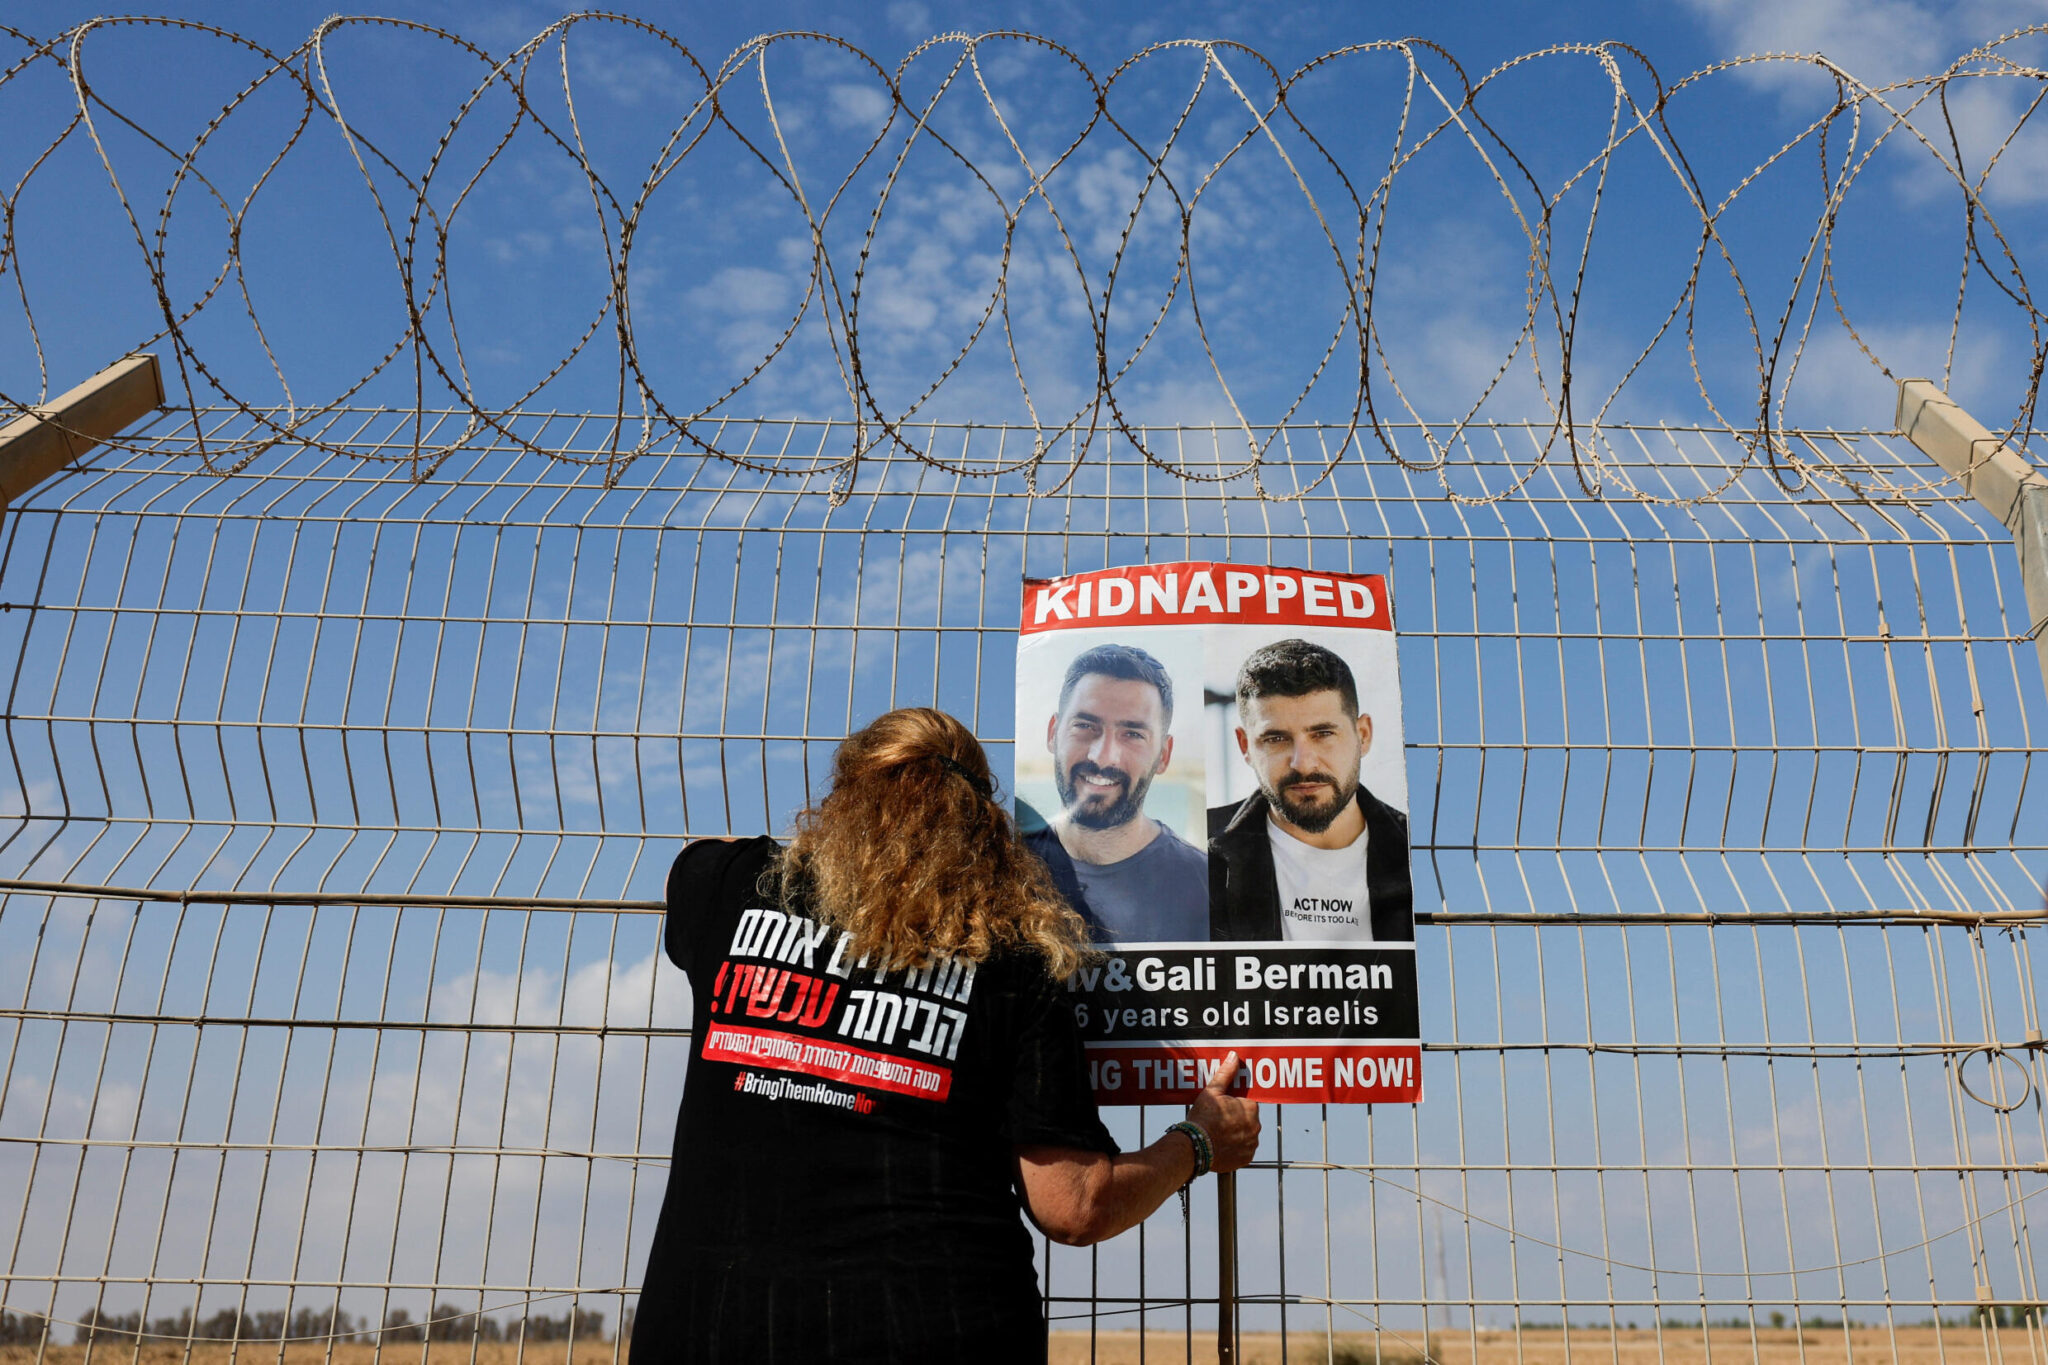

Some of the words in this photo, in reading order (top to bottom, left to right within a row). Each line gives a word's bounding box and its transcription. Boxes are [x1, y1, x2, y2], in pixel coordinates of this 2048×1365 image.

[1034, 571, 1376, 625] KIDNAPPED
[1294, 898, 1319, 911] ACT
[1321, 899, 1353, 912] NOW
[1314, 915, 1326, 923] ITS
[1328, 915, 1344, 923] TOO
[729, 909, 830, 969] אותם
[1067, 956, 1216, 992] iv&Gali
[1235, 955, 1393, 991] Berman
[710, 960, 840, 1028] עכשיו!
[837, 989, 968, 1061] הביתה
[1074, 1002, 1089, 1028] 6
[1103, 1005, 1189, 1034] years
[1202, 1001, 1250, 1027] old
[1264, 1000, 1379, 1026] Israelis
[708, 1031, 752, 1054] והנעדרים
[751, 1035, 803, 1062] החטופים
[802, 1045, 852, 1071] להחזרת
[849, 1054, 913, 1085] המשפחות
[912, 1068, 941, 1092] מטה
[1132, 1058, 1221, 1090] THEM
[1233, 1057, 1323, 1089] HOME
[1334, 1057, 1414, 1089] NOW!
[733, 1072, 878, 1115] #BringThemHomeNo
